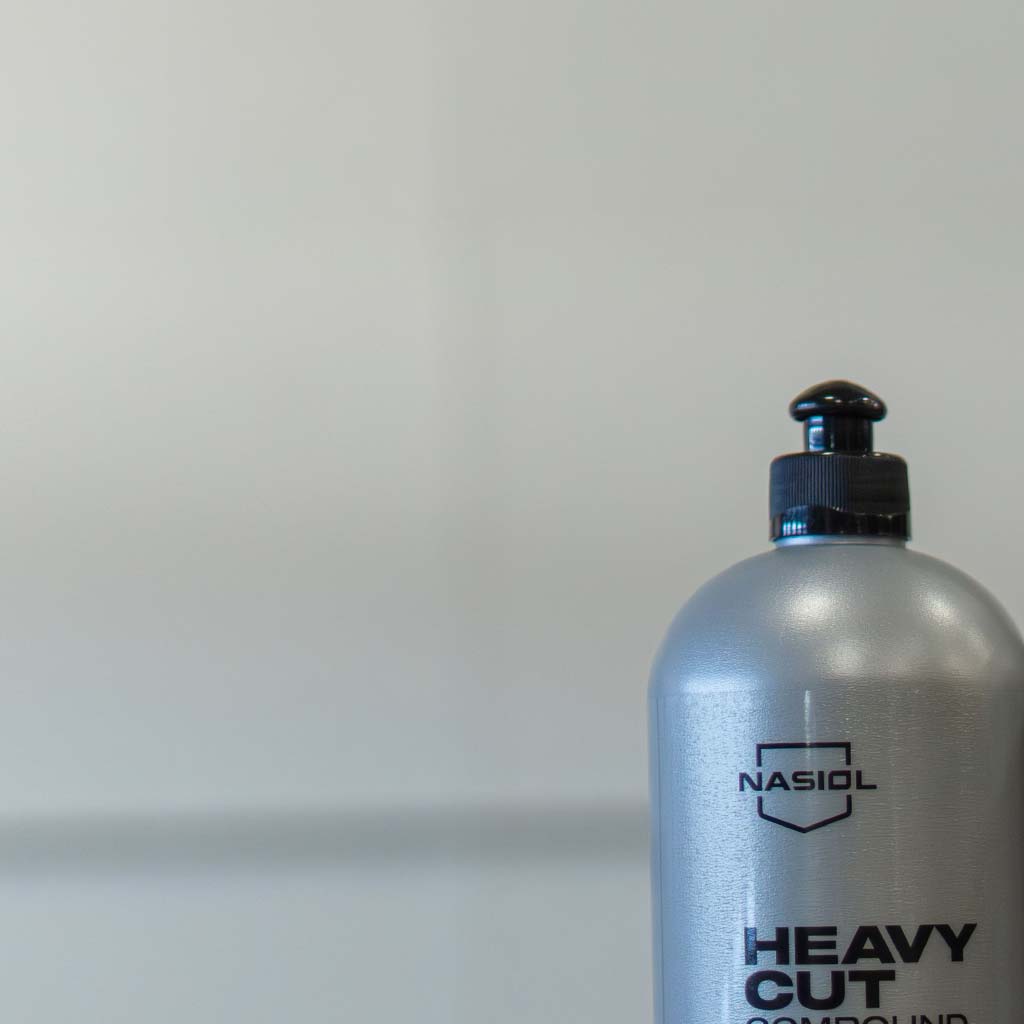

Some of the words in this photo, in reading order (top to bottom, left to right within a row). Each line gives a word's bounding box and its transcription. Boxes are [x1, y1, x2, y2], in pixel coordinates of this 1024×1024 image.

[738, 770, 877, 792] NASIOL
[744, 923, 977, 965] HEAVY
[744, 969, 896, 1011] CUT
